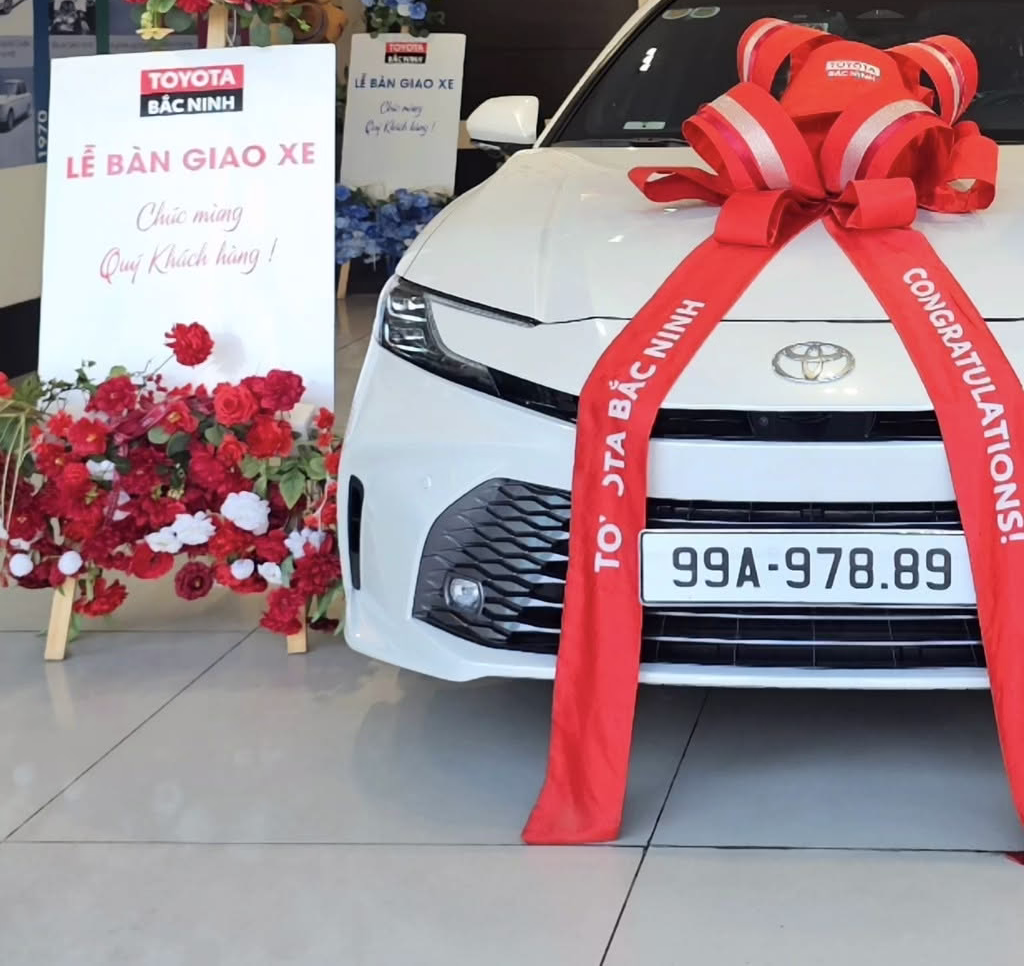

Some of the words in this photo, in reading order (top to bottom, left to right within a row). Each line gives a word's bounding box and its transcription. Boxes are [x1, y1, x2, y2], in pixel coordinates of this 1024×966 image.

[147, 68, 236, 90] TOYOTA
[400, 78, 434, 90] GIAO
[438, 79, 455, 90] XE
[147, 94, 185, 115] BẮC
[187, 95, 236, 113] NINH
[37, 110, 48, 158] 1970
[66, 144, 96, 179] LỄ
[106, 146, 170, 176] BÀN
[182, 144, 267, 172] GIAO
[277, 142, 316, 166] XE
[136, 201, 188, 232] Chúc
[99, 247, 141, 284] Quý
[148, 241, 209, 275] Khách
[215, 240, 260, 275] hàng
[648, 299, 705, 360] NINH
[608, 364, 658, 422] BẮC
[594, 431, 626, 574] TOOTA
[671, 546, 954, 591] 99A-978.89
